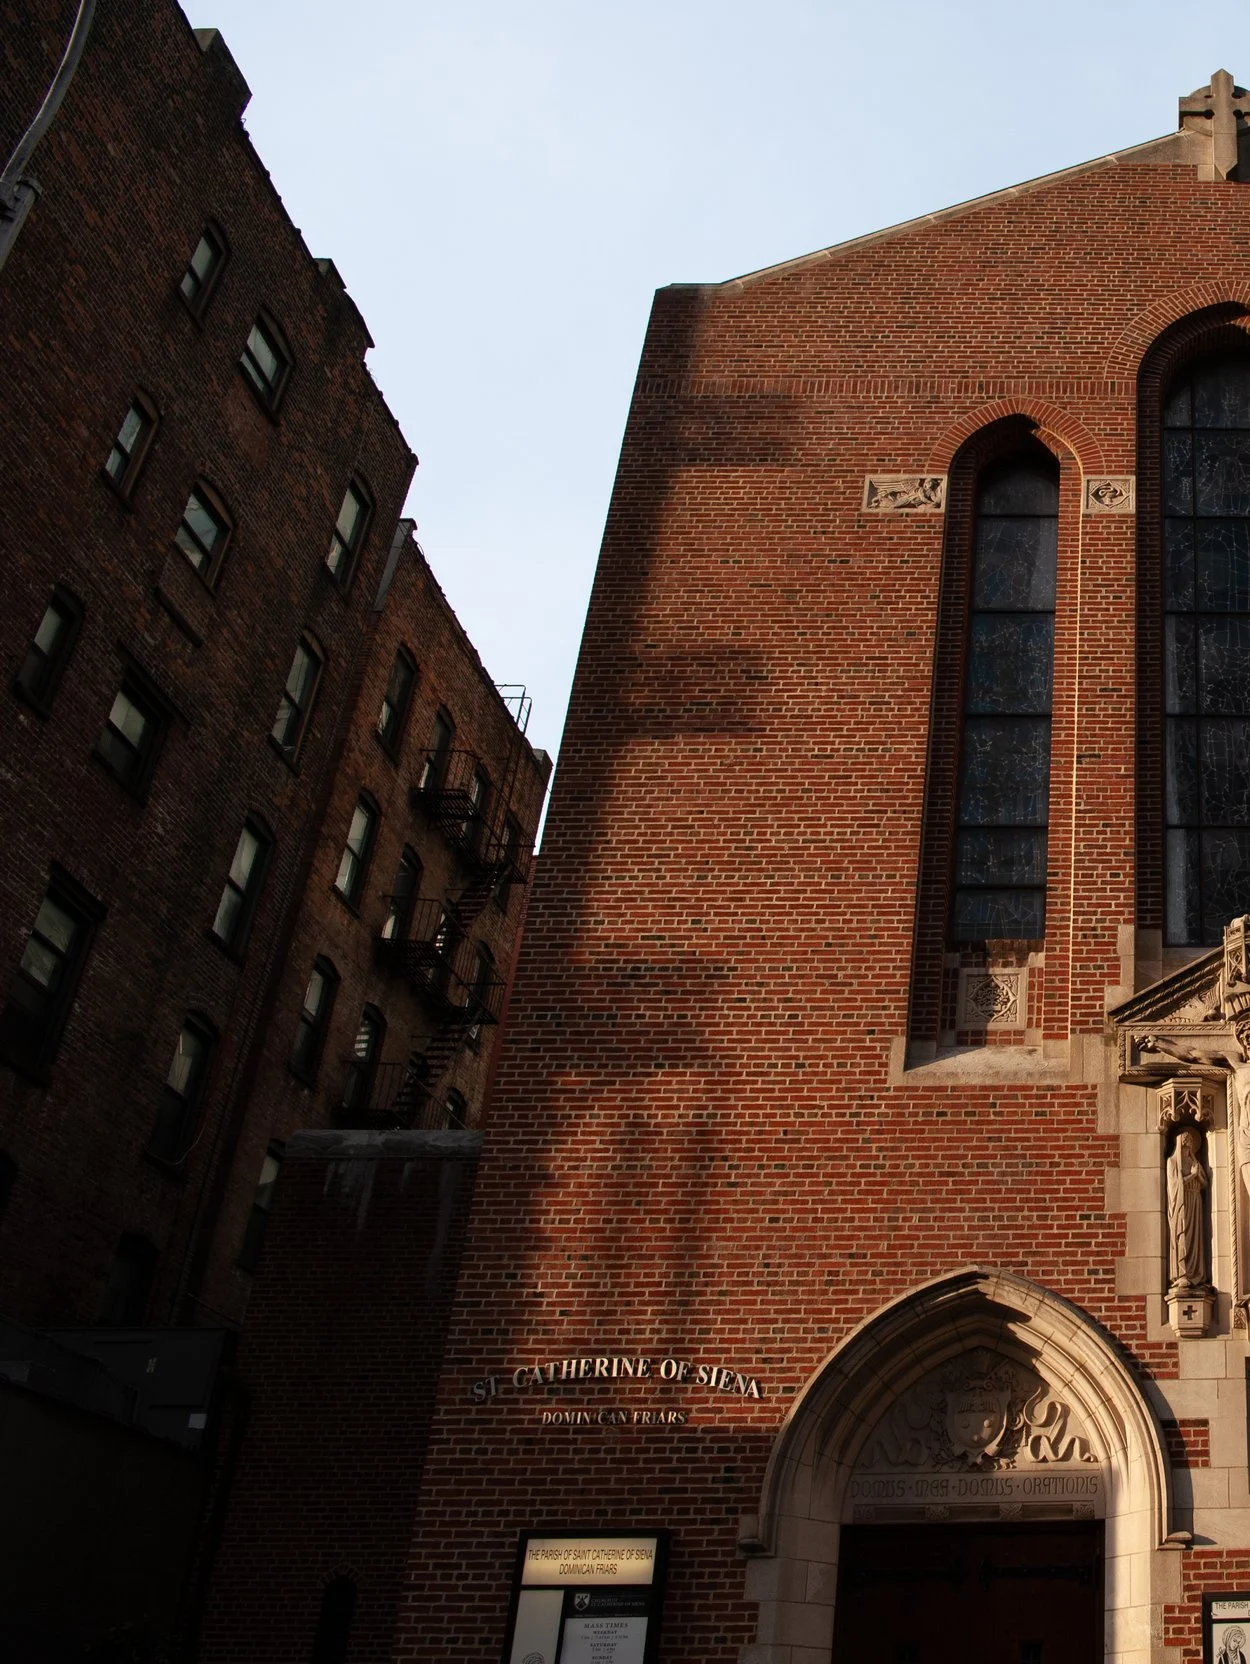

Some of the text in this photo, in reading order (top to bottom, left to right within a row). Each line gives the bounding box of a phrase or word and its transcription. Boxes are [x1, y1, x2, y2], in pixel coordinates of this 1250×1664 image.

[472, 1357, 763, 1402] ST CATHERINE OF SIENA
[633, 1410, 688, 1425] FRIARS
[528, 1549, 653, 1560] THE PARISH OF SAINT CATHERINE OF SIENA
[559, 1563, 618, 1575] DOMINICAN FRIARS
